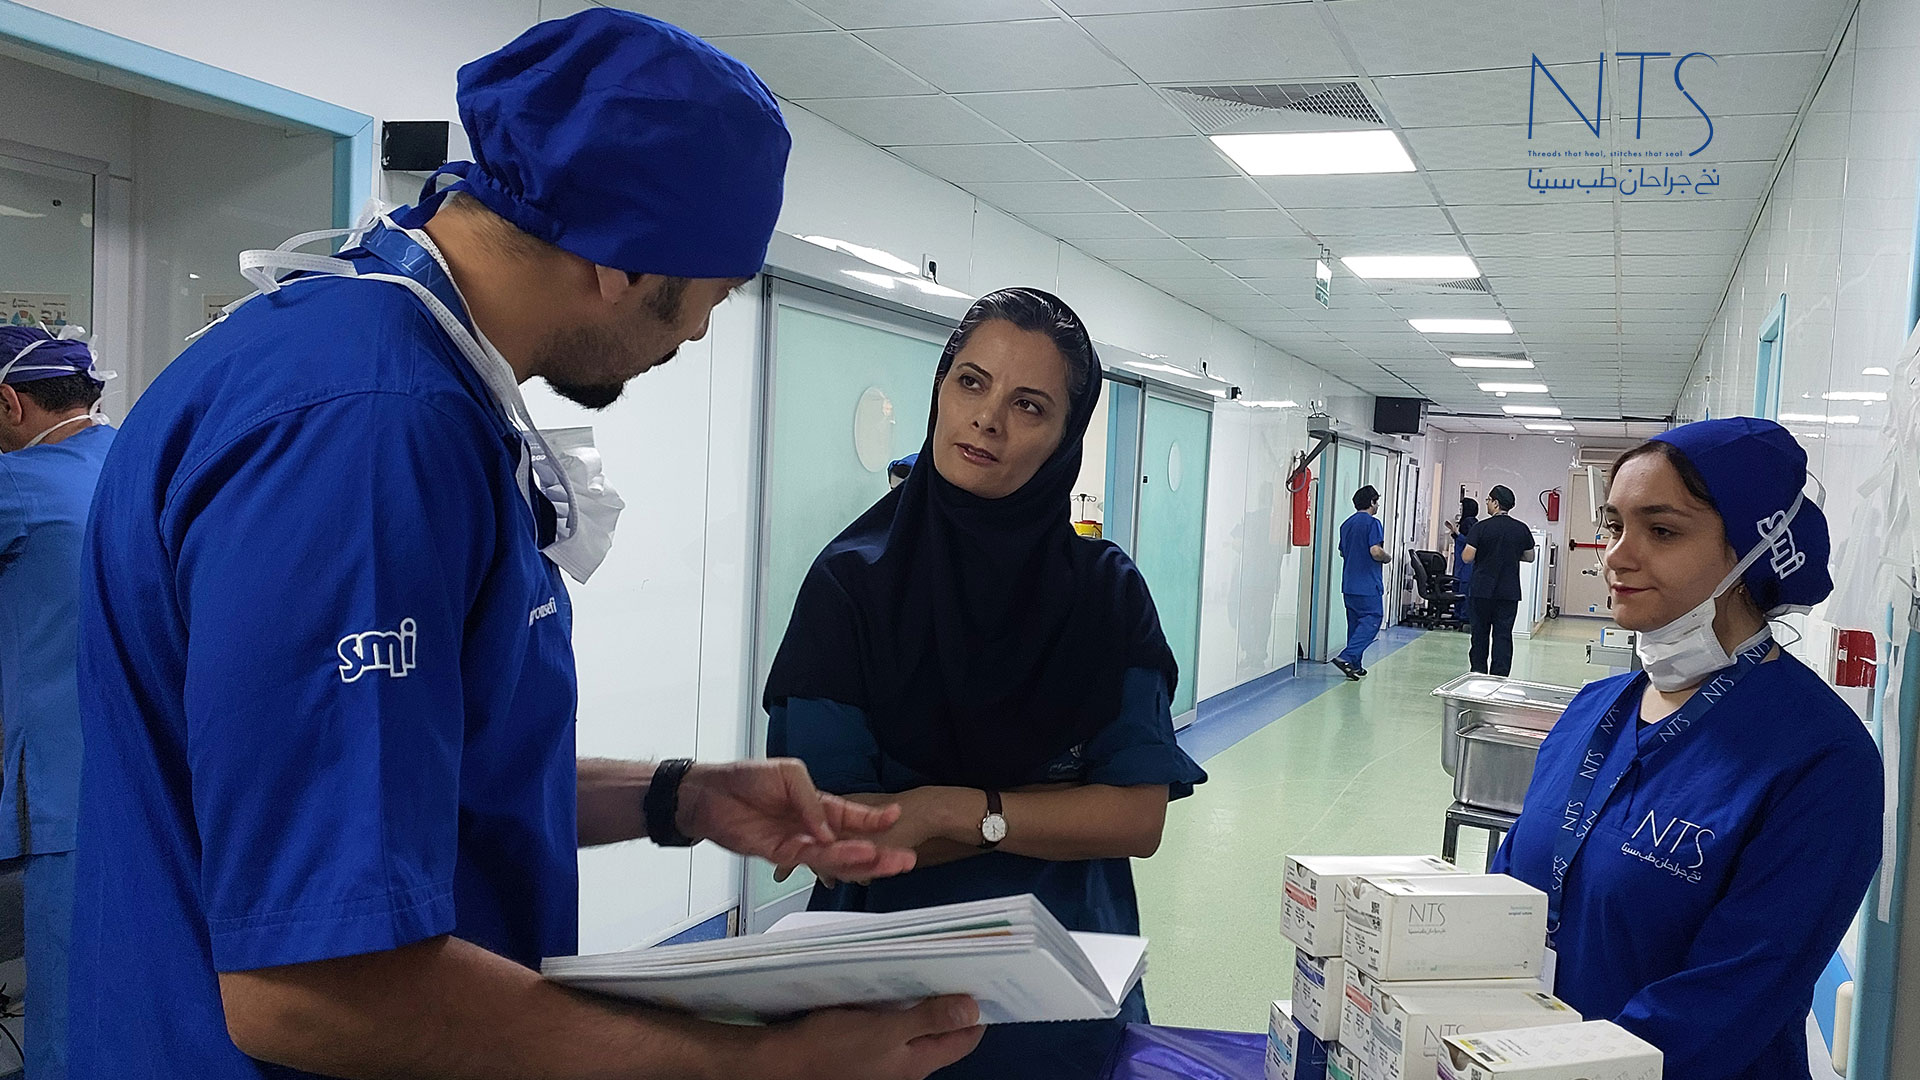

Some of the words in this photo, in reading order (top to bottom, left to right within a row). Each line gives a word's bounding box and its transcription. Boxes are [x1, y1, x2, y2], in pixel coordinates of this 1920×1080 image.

[337, 617, 417, 683] smi
[1701, 673, 1735, 704] NTS
[1659, 713, 1691, 743] NTS
[1579, 749, 1605, 780] NTS
[1561, 799, 1584, 831] NTS
[1631, 809, 1716, 868] NTS
[1409, 903, 1446, 927] NTS
